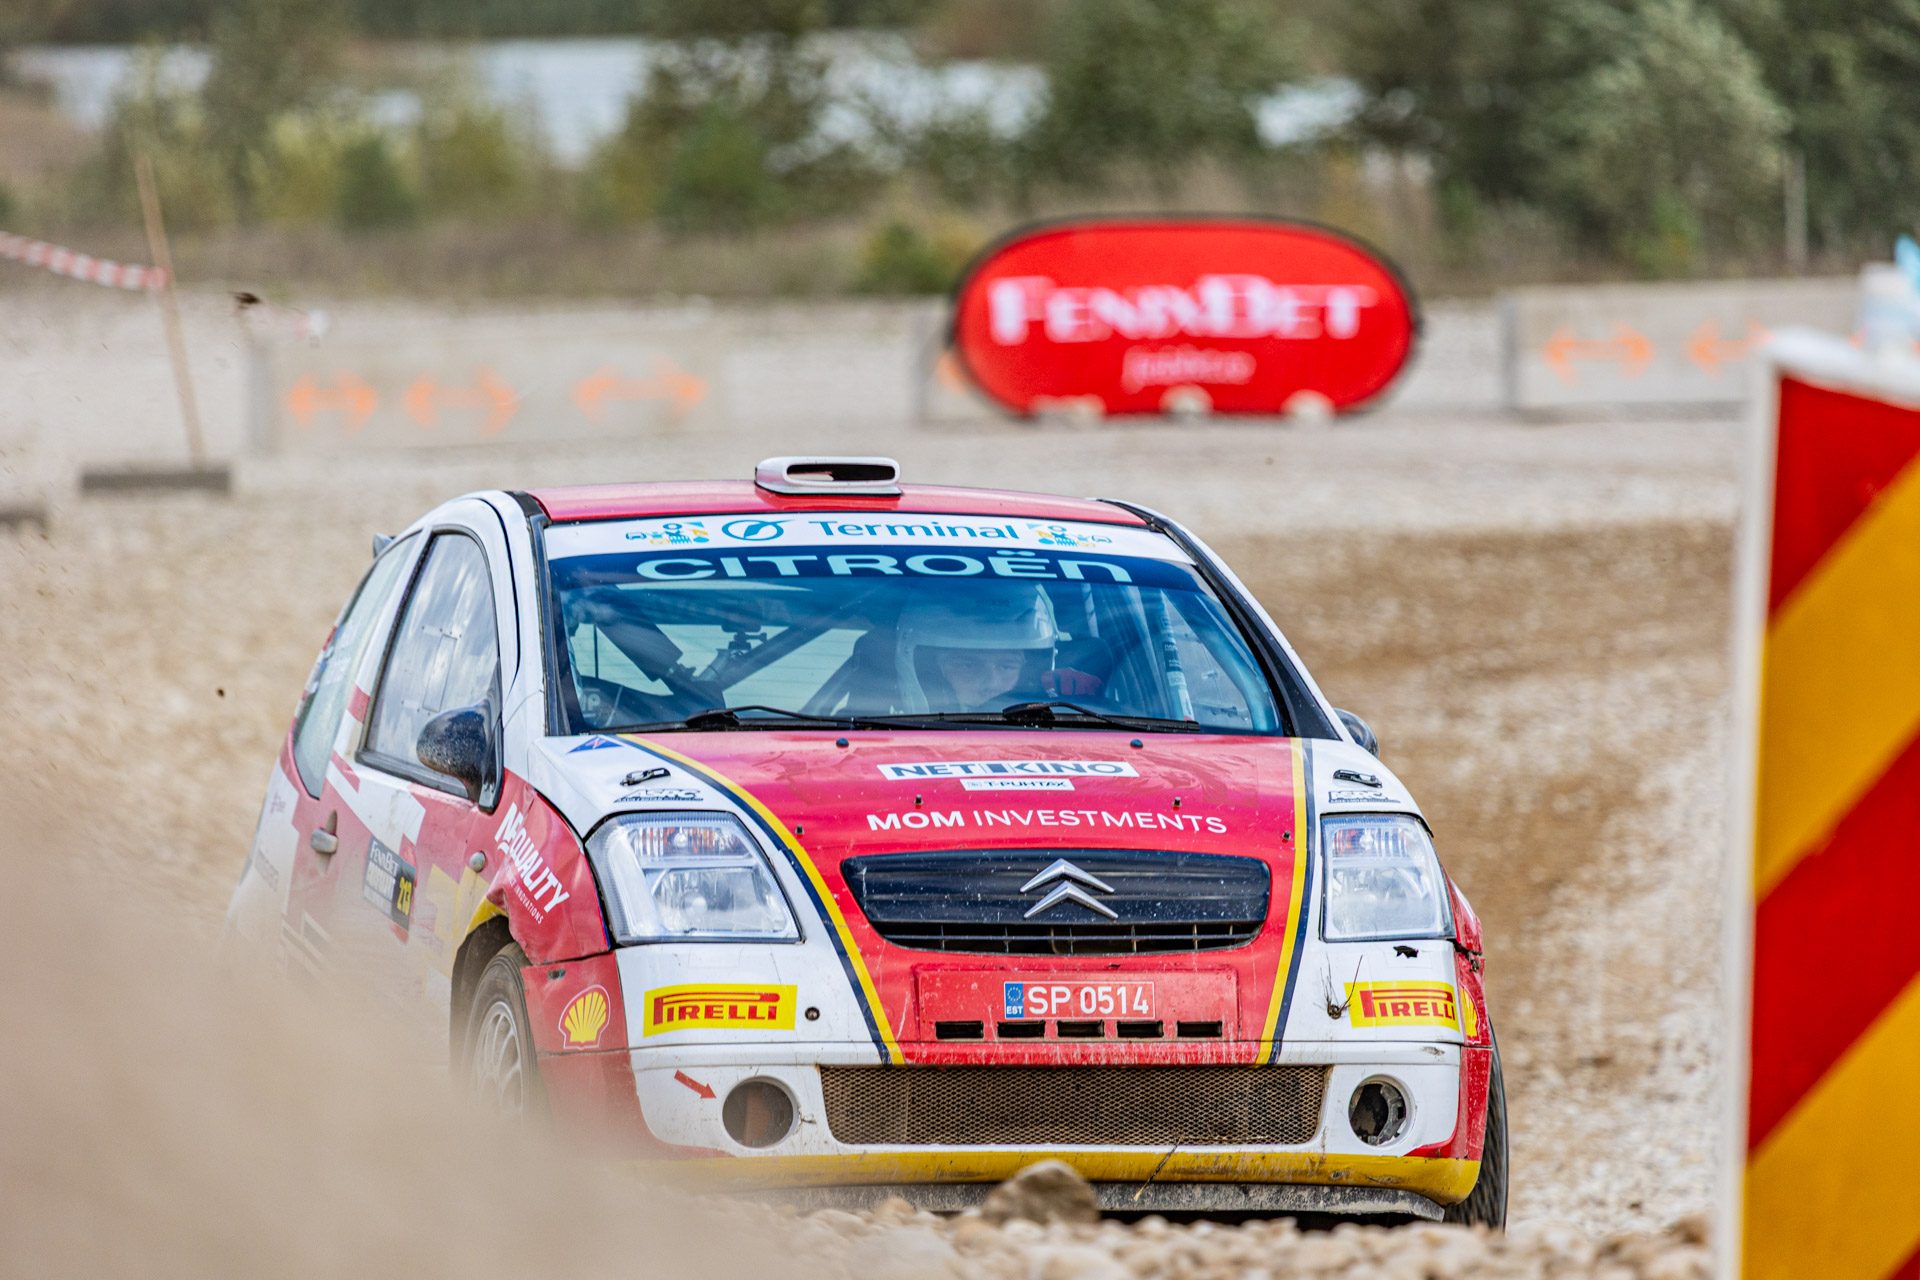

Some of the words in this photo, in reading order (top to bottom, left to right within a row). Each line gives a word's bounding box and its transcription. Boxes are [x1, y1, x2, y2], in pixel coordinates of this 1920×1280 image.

[808, 520, 1019, 540] Terminal
[866, 811, 965, 831] MOM
[972, 809, 1228, 834] INVESTMENTS
[653, 992, 780, 1026] PIRELLI
[1006, 1005, 1024, 1015] EST
[1028, 985, 1072, 1015] SP
[1080, 985, 1150, 1015] 0514
[1359, 988, 1456, 1021] PIRELLI
